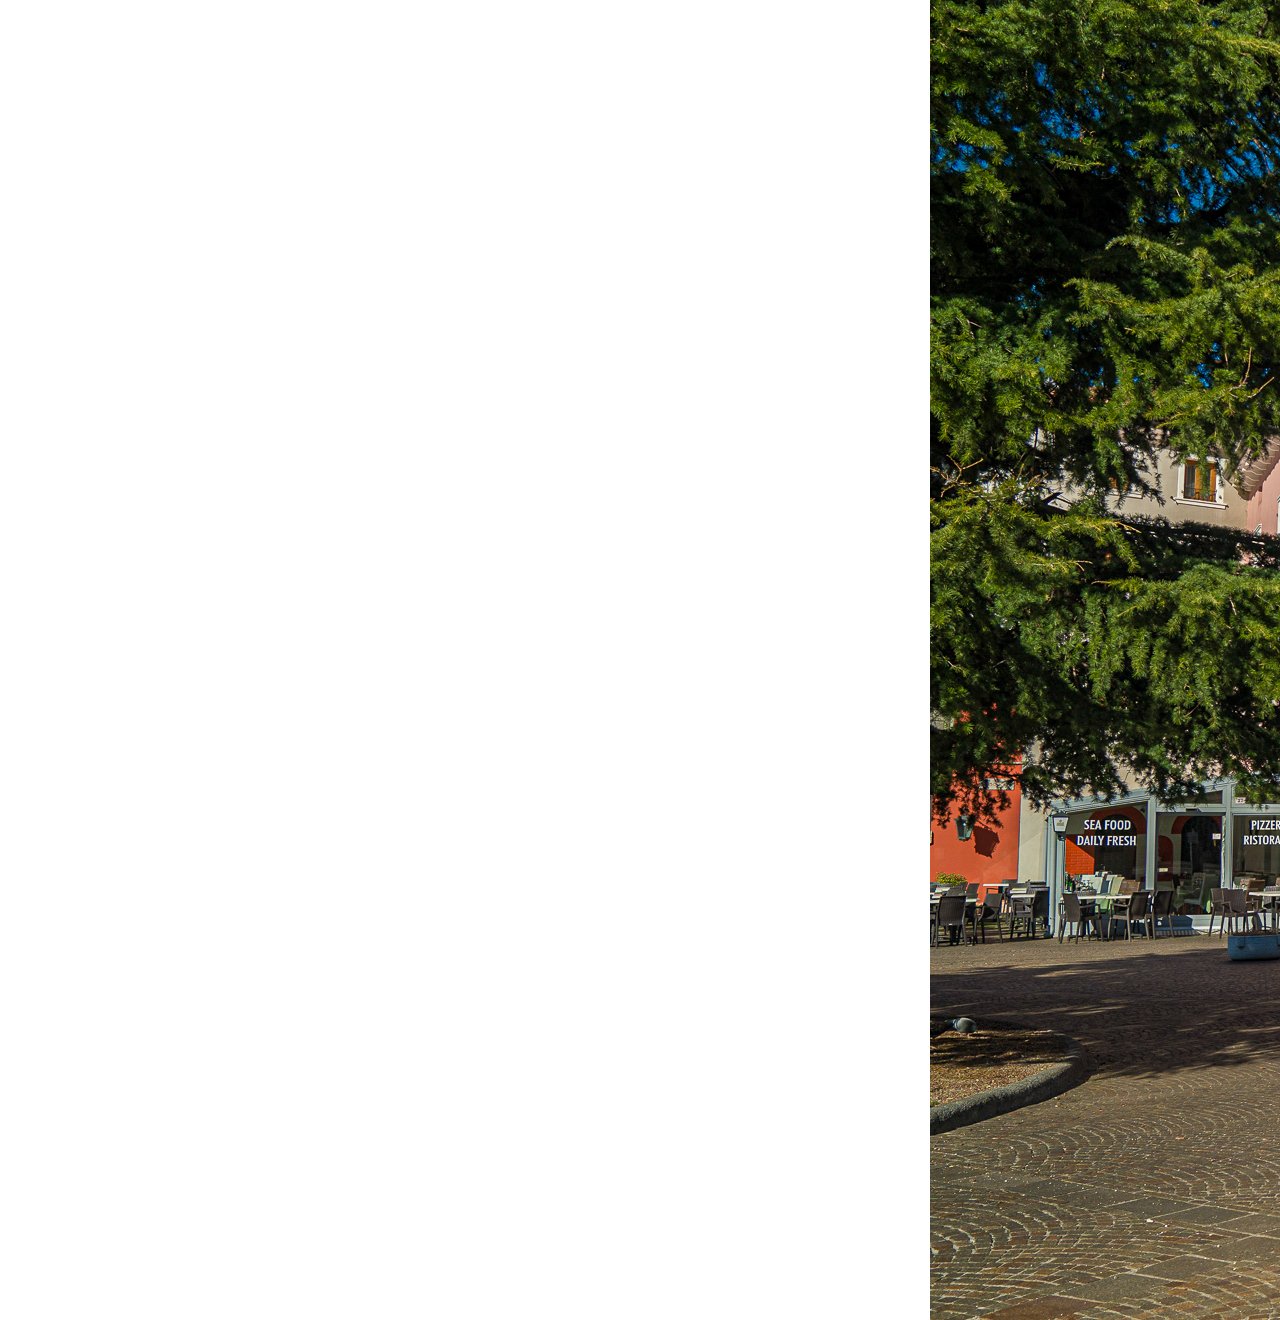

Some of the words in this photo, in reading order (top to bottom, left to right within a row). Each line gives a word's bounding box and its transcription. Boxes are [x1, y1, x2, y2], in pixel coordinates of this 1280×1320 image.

[1083, 819, 1102, 831] SEA
[1104, 819, 1132, 831] FOOD
[1076, 835, 1105, 846] DAILY
[1106, 835, 1137, 846] FRESH
